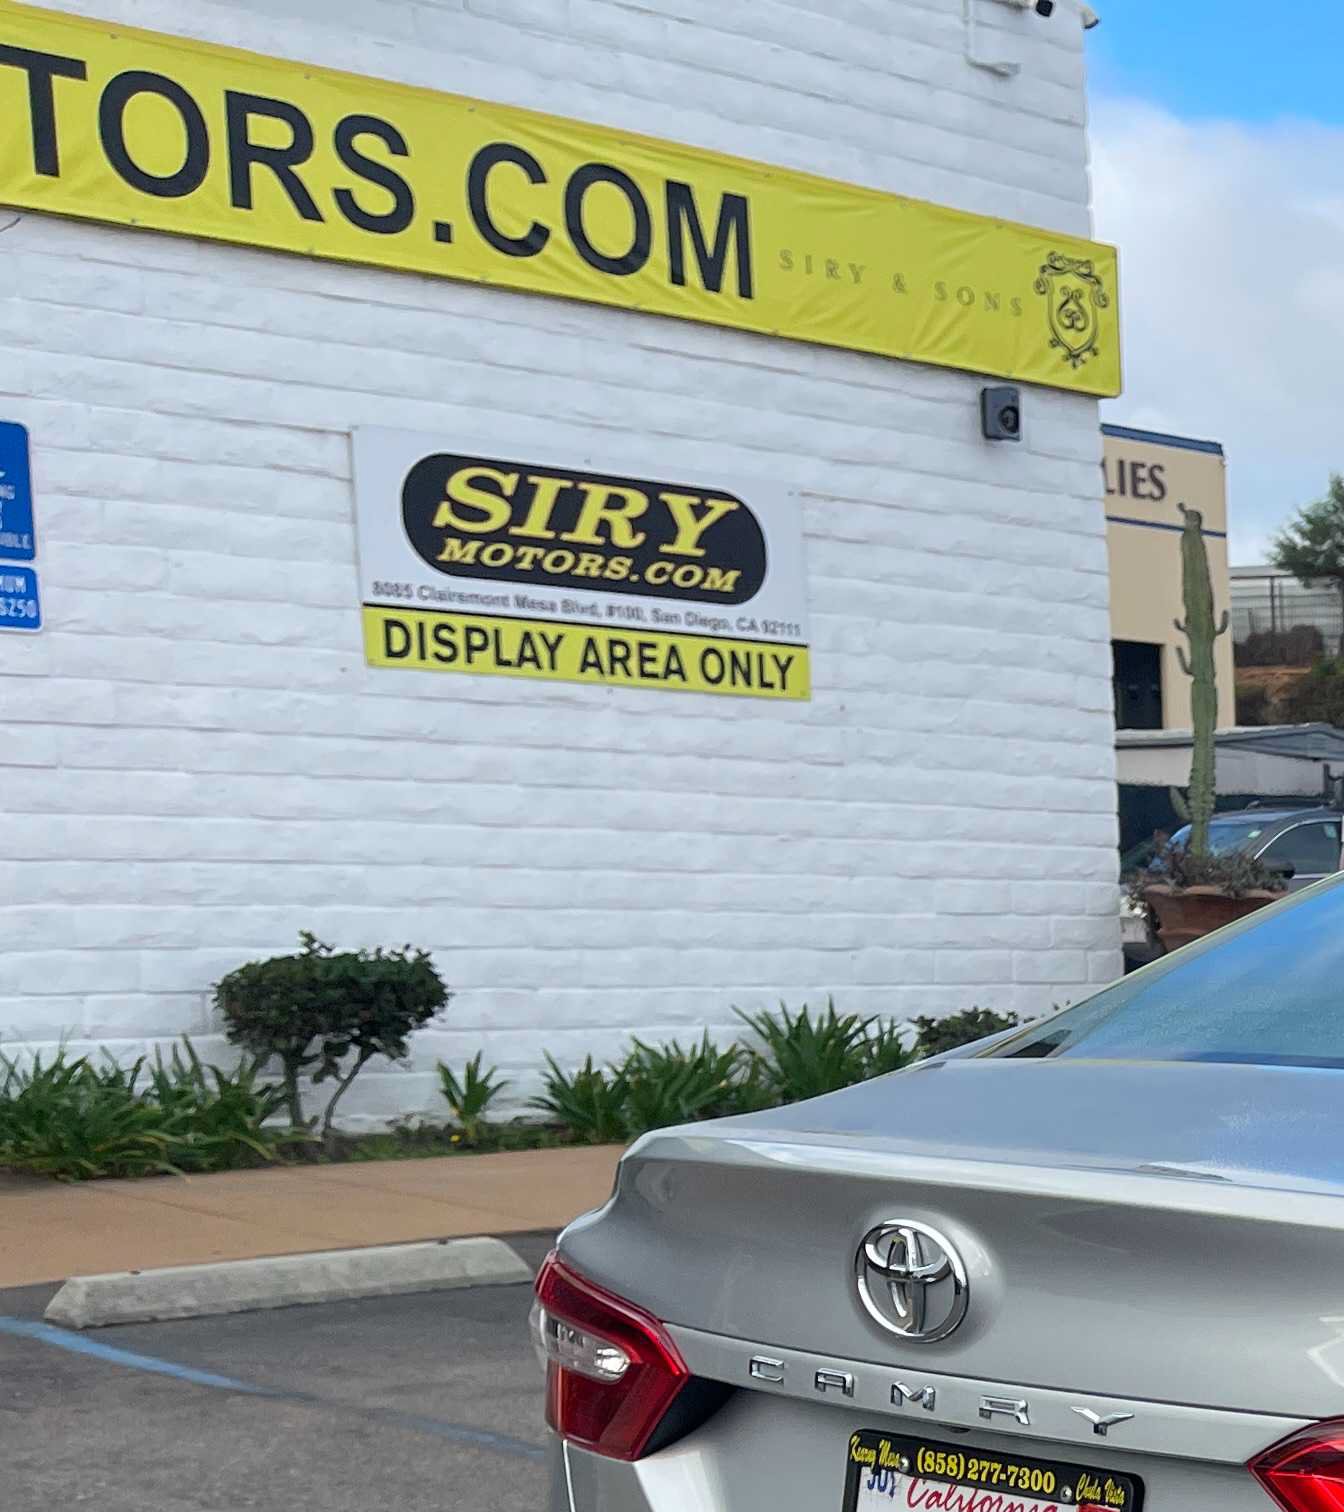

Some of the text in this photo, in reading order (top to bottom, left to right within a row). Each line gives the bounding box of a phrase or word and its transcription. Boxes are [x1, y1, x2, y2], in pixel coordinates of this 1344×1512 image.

[778, 248, 1023, 317] SIRY & SONS
[432, 466, 739, 557] SIRY
[437, 537, 742, 594] MOTORS.COM
[417, 583, 510, 608] Clairemont
[514, 594, 558, 613] Mesa
[651, 607, 681, 625] San
[736, 617, 760, 632] CA
[383, 617, 796, 691] DISPLAY AREA ONLY
[748, 1354, 1136, 1438] CAMRY
[916, 1446, 965, 1481] (858)
[966, 1457, 1056, 1495] 277-7300
